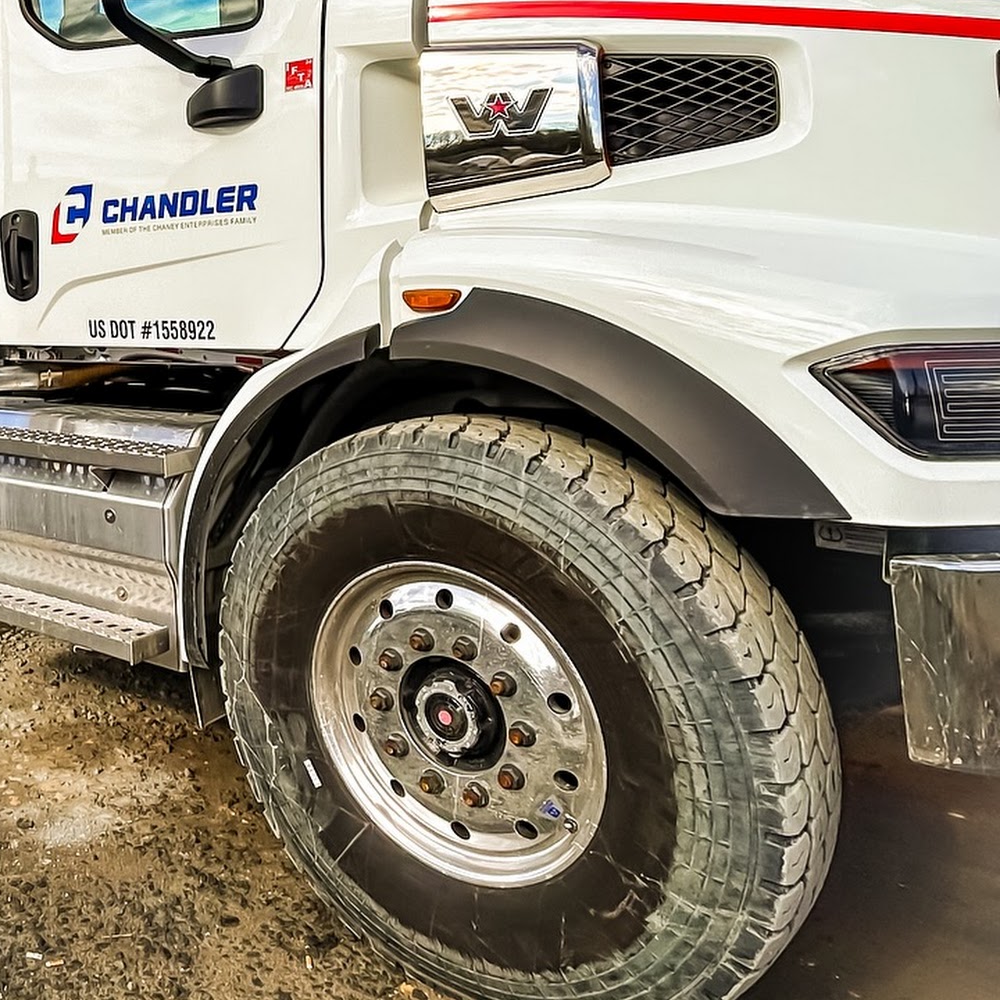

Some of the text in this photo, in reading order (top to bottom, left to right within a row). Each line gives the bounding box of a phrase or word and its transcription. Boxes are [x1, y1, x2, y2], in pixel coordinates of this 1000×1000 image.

[102, 183, 259, 224] CHANDLER
[101, 216, 258, 236] MEMBER OF THE CHANEY ENTERPRISES FAMILY
[88, 319, 216, 340] US DOT #1558922
